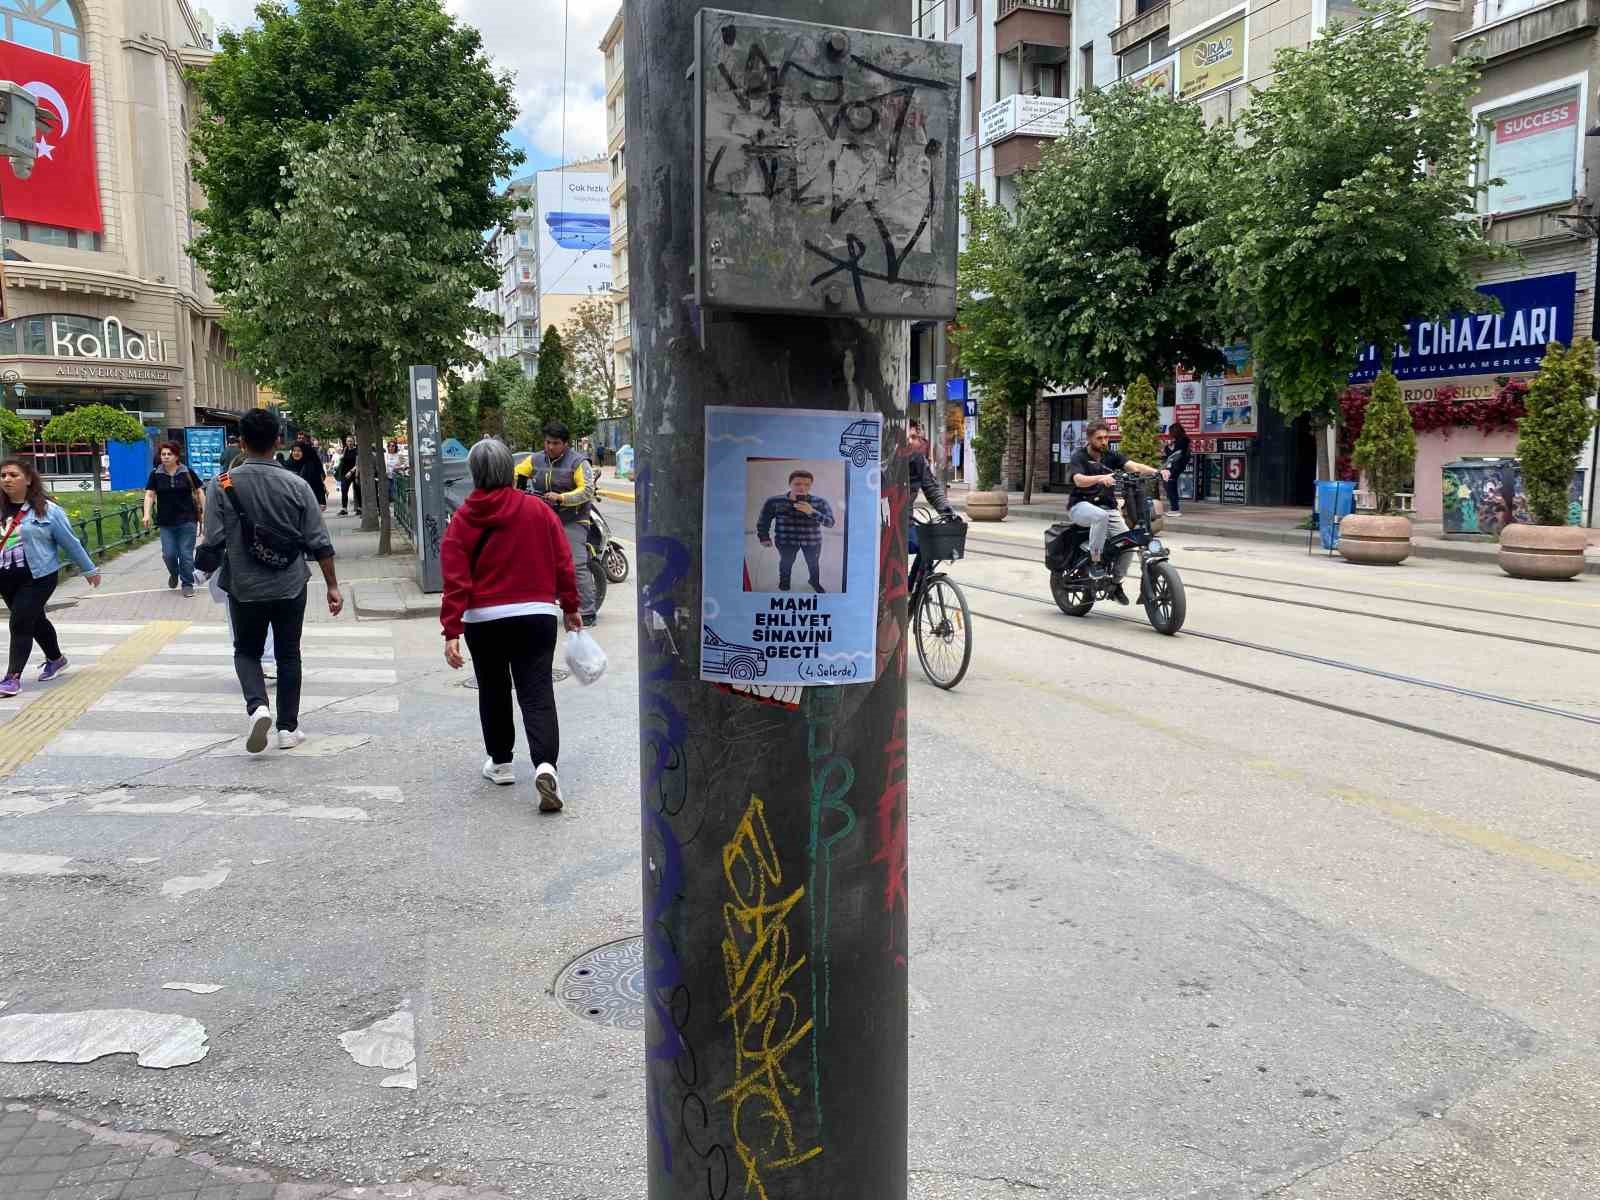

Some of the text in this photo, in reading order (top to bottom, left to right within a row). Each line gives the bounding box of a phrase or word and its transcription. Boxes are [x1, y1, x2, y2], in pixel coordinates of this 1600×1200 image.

[1504, 106, 1569, 135] SUCCESS
[1229, 458, 1242, 480] 5
[770, 595, 818, 611] MAMİ
[755, 611, 831, 627] EHLİYET
[752, 627, 832, 643] SİNAVİNİ
